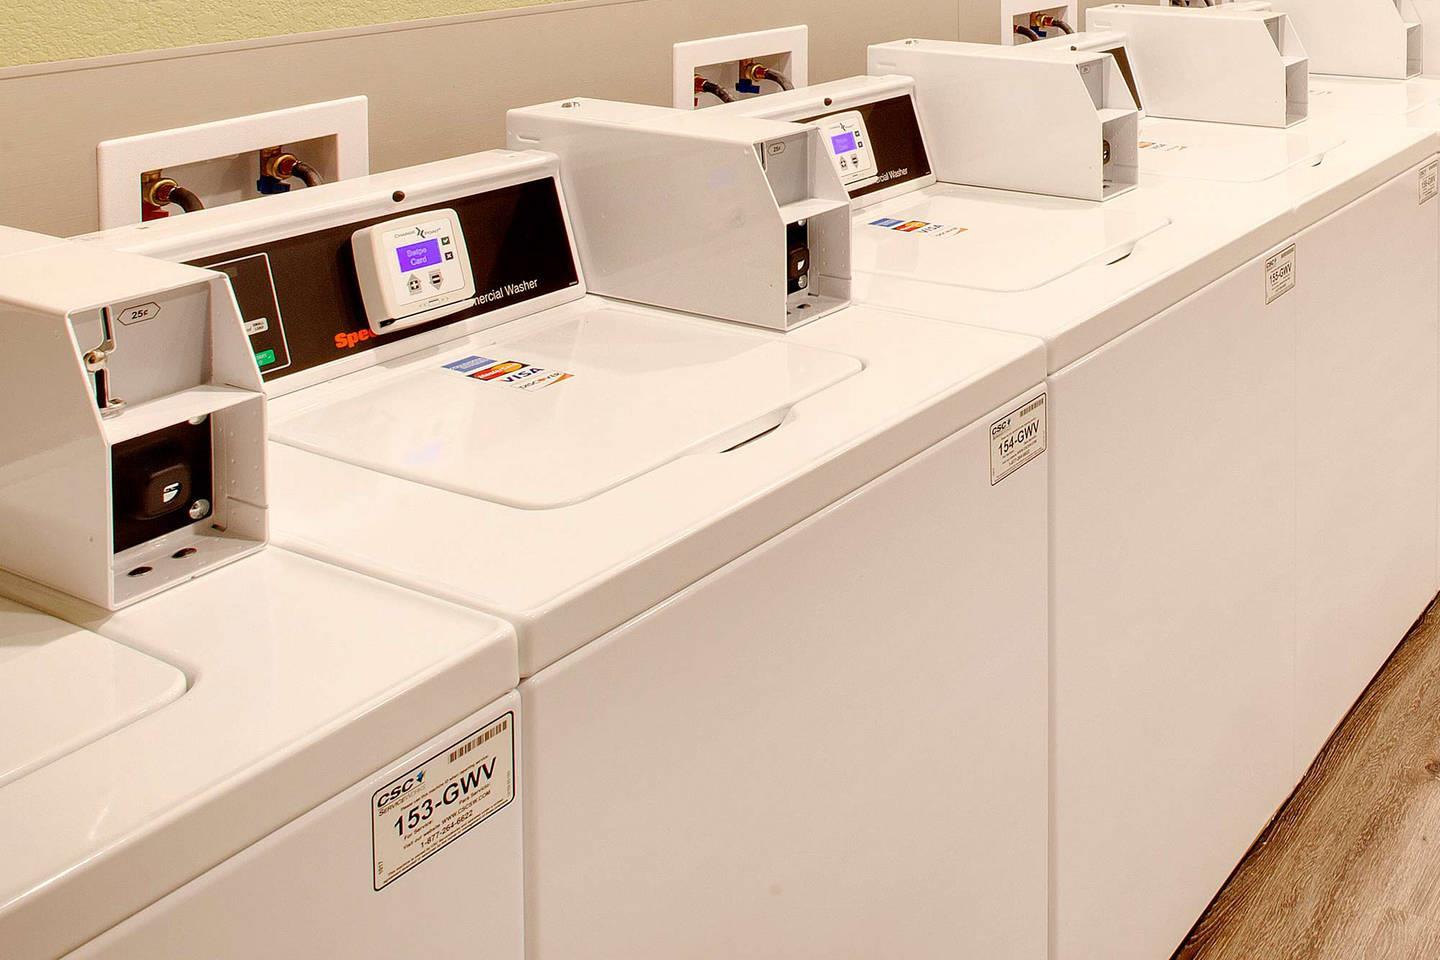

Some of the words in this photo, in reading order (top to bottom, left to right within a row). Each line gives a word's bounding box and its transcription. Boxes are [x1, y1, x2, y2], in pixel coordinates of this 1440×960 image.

[406, 247, 427, 259] Swipe
[410, 256, 428, 266] Card
[504, 279, 538, 296] Washer
[503, 367, 545, 383] VISA
[992, 420, 1007, 436] CSC
[998, 419, 1040, 456] 154-GWV
[377, 778, 414, 808] CSC
[394, 756, 497, 836] 153-GWV
[420, 807, 472, 848] 1-877-264-6622
